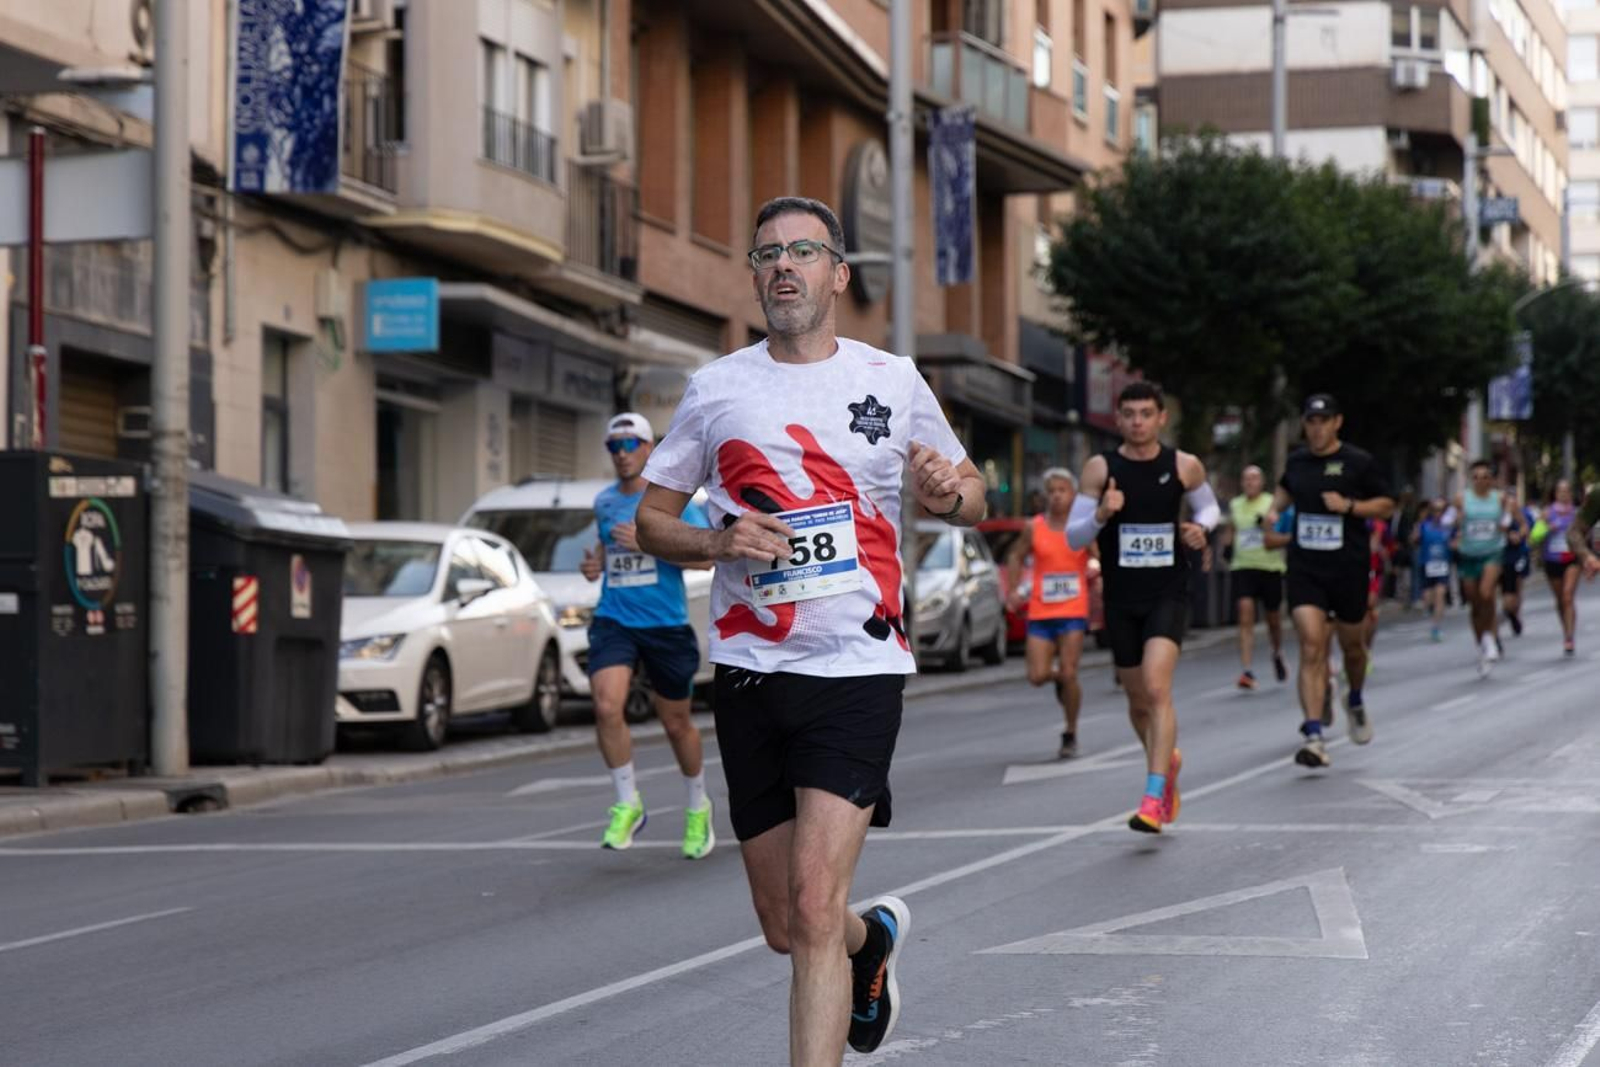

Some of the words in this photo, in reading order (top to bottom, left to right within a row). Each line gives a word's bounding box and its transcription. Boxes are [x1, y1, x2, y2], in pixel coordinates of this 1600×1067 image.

[770, 532, 837, 570] 58
[1131, 537, 1164, 551] 498
[613, 555, 644, 571] 487
[783, 566, 823, 578] FRANCISCO
